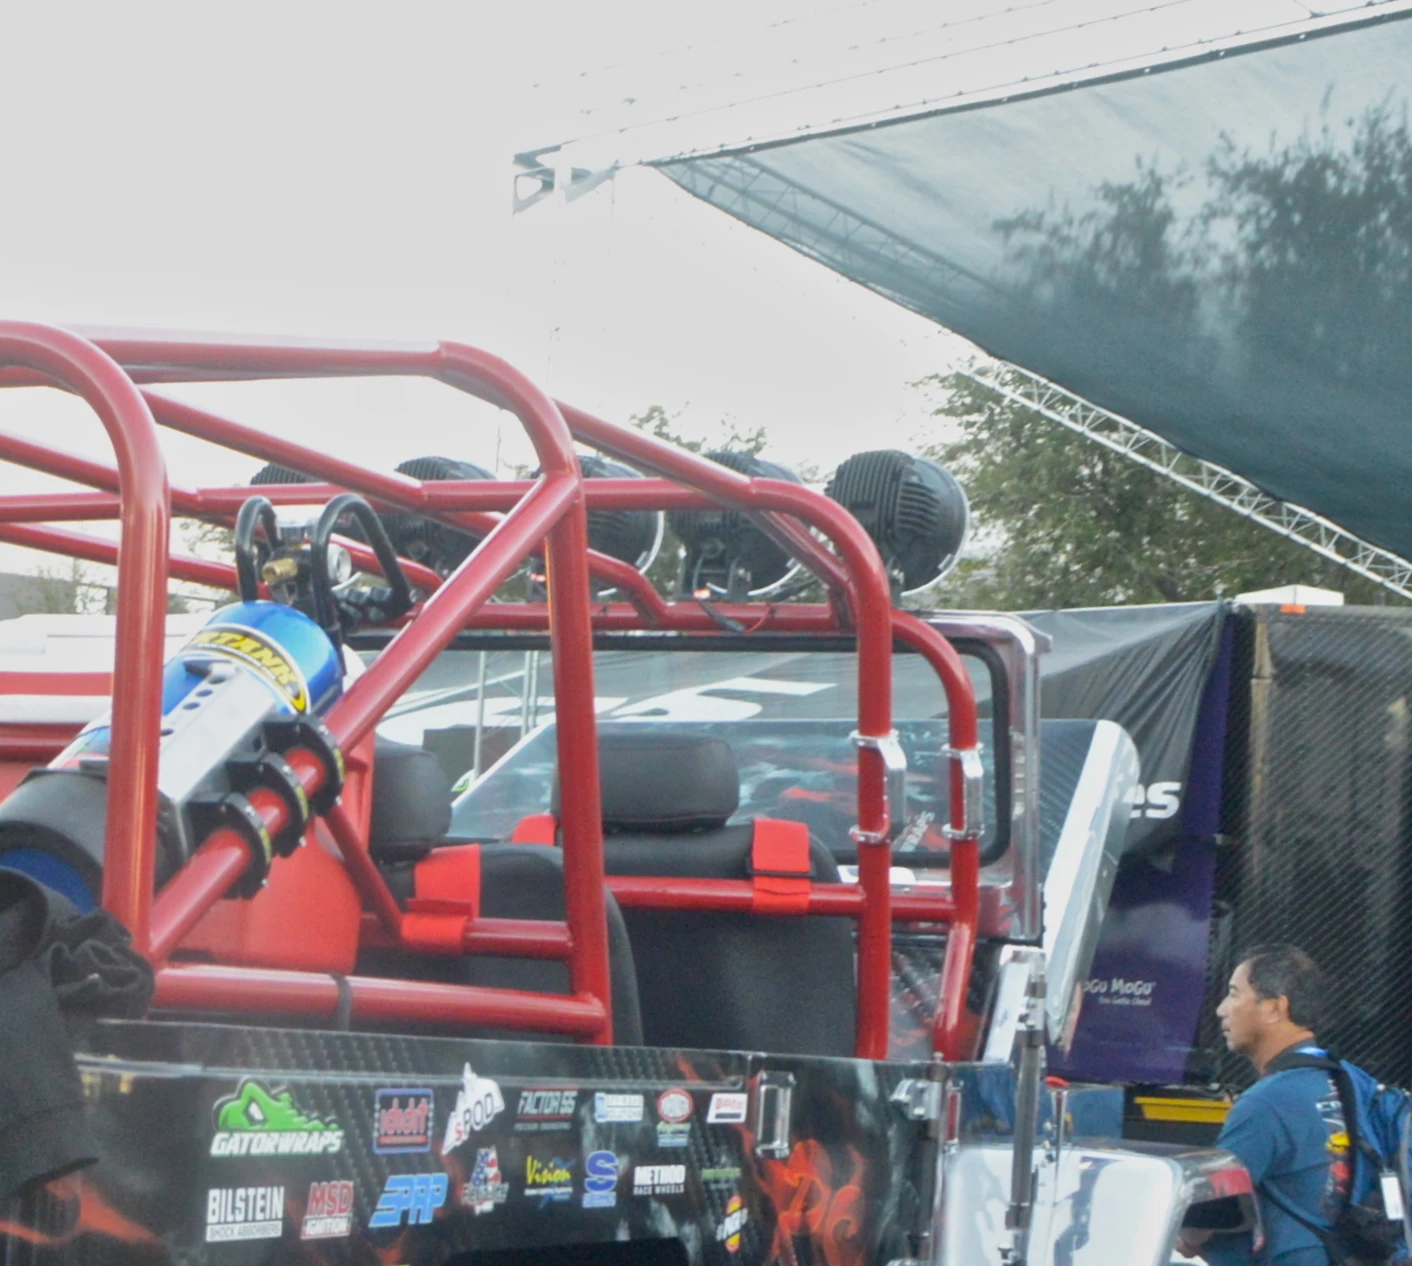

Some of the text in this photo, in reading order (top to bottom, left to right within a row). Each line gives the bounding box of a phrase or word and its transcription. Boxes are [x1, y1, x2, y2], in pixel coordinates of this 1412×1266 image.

[210, 1130, 344, 1156] GATORWRAPS
[526, 1155, 572, 1185] Vision
[634, 1164, 686, 1186] METHOD
[206, 1185, 285, 1224] BILSTEIN
[307, 1180, 354, 1215] MSD
